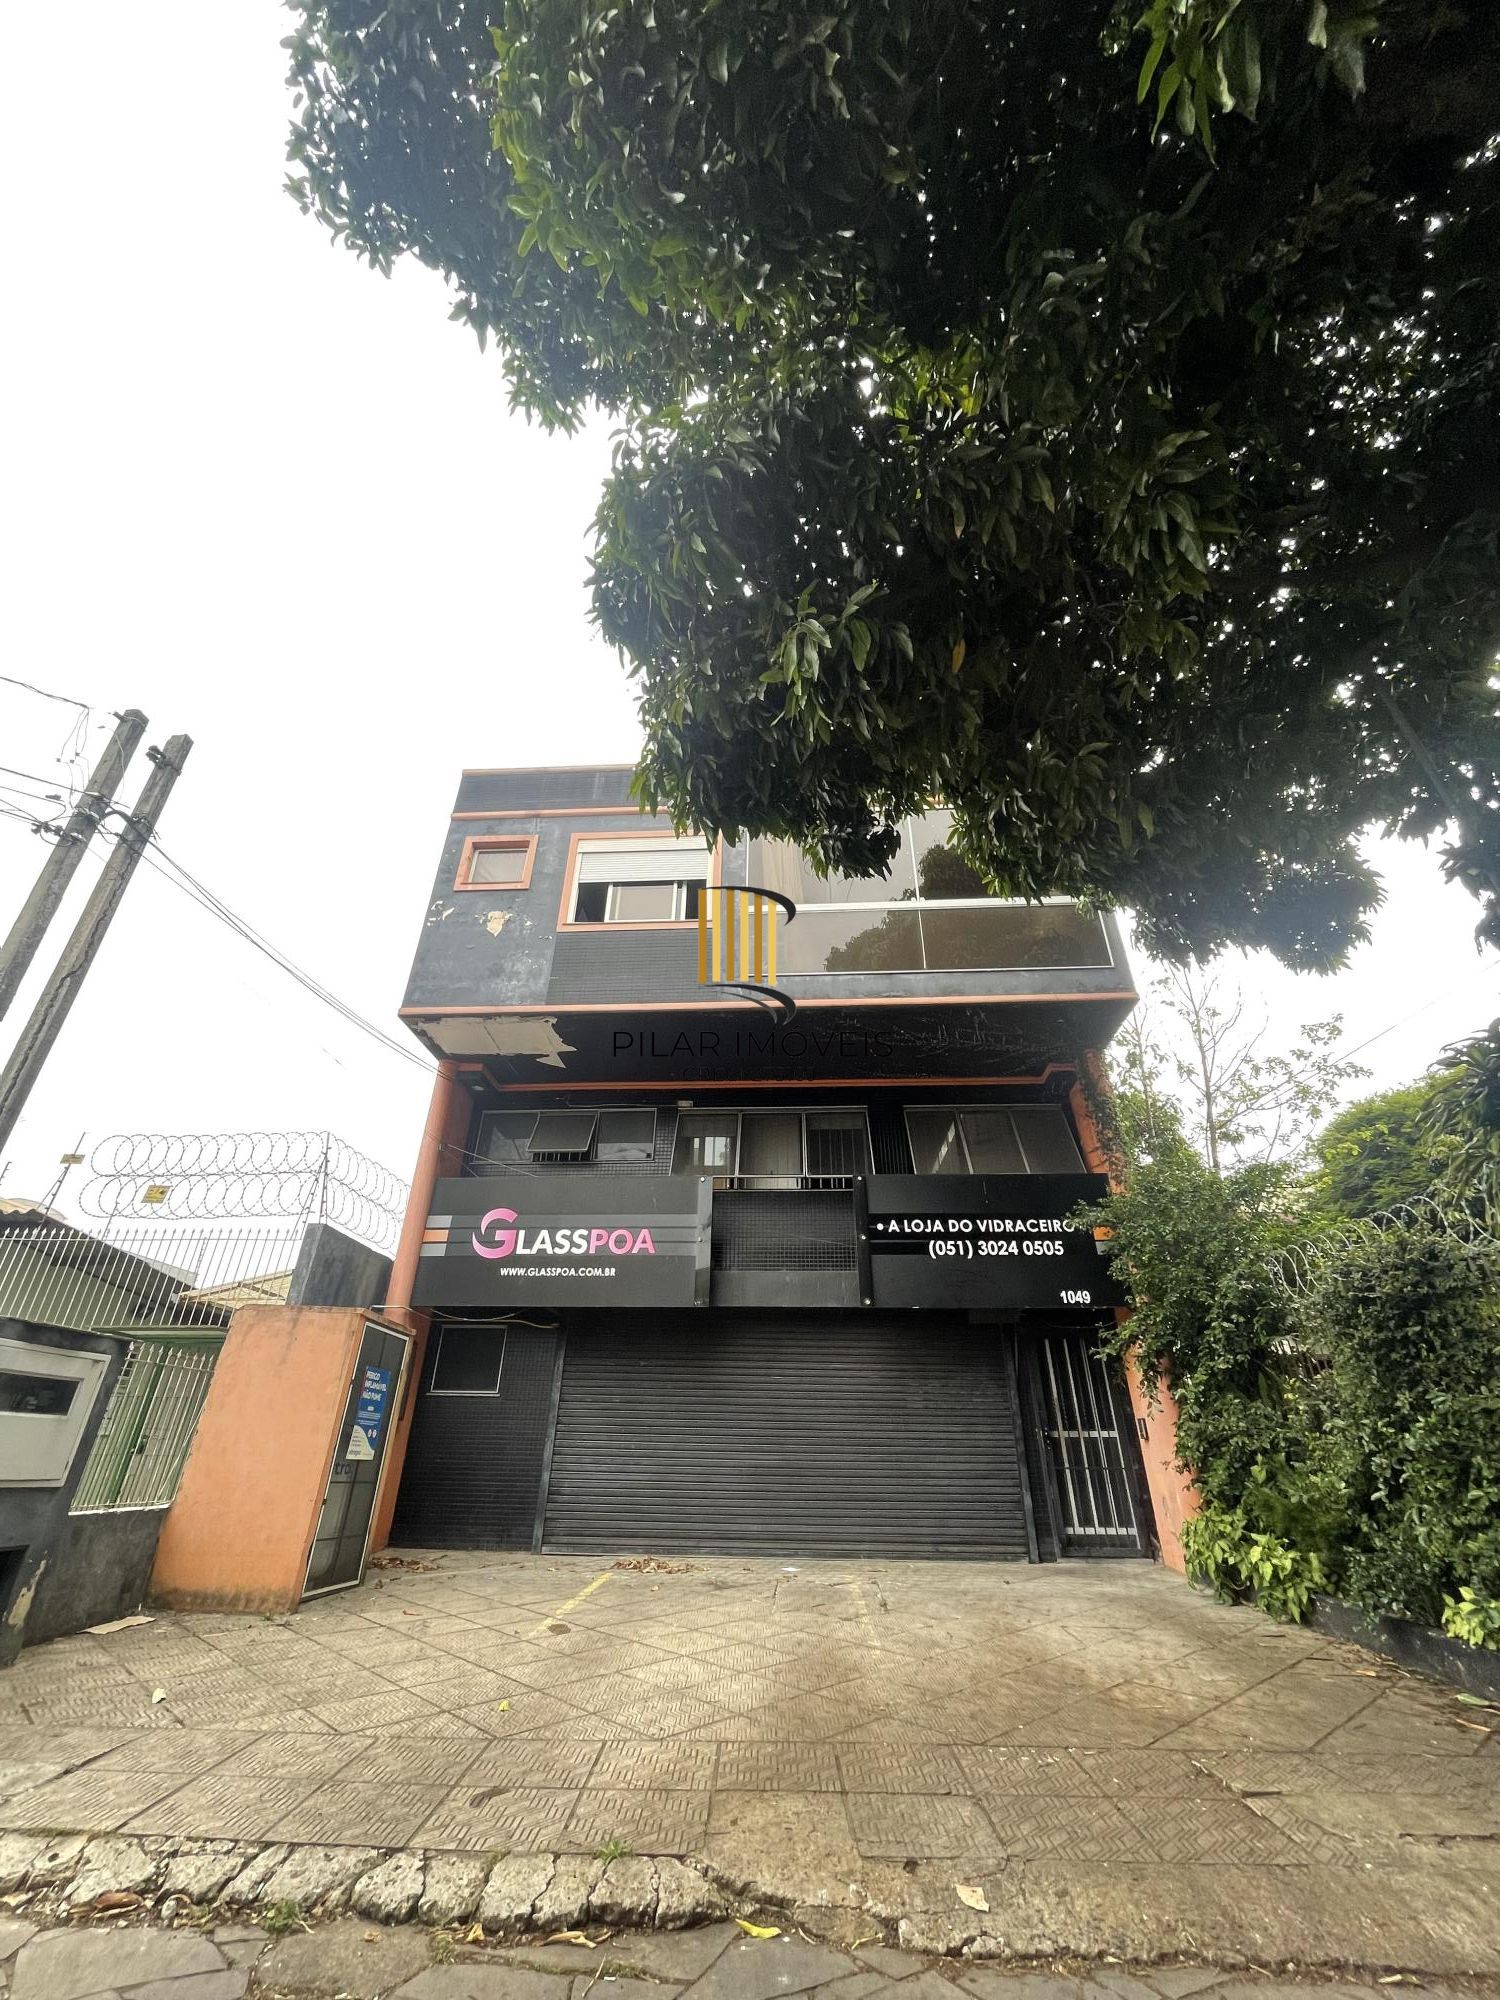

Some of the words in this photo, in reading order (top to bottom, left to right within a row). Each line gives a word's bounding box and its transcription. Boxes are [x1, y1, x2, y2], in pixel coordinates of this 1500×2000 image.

[888, 1219, 900, 1233] A
[903, 1219, 945, 1233] LOJA
[948, 1219, 973, 1233] DO
[976, 1219, 1076, 1233] VIDRACEIRO
[928, 1239, 973, 1260] (051)
[977, 1240, 1018, 1256] 3024
[1022, 1240, 1064, 1256] 0505
[500, 1266, 616, 1278] WWW.GLASSPOA.COM.BR
[1060, 1290, 1091, 1304] 1049
